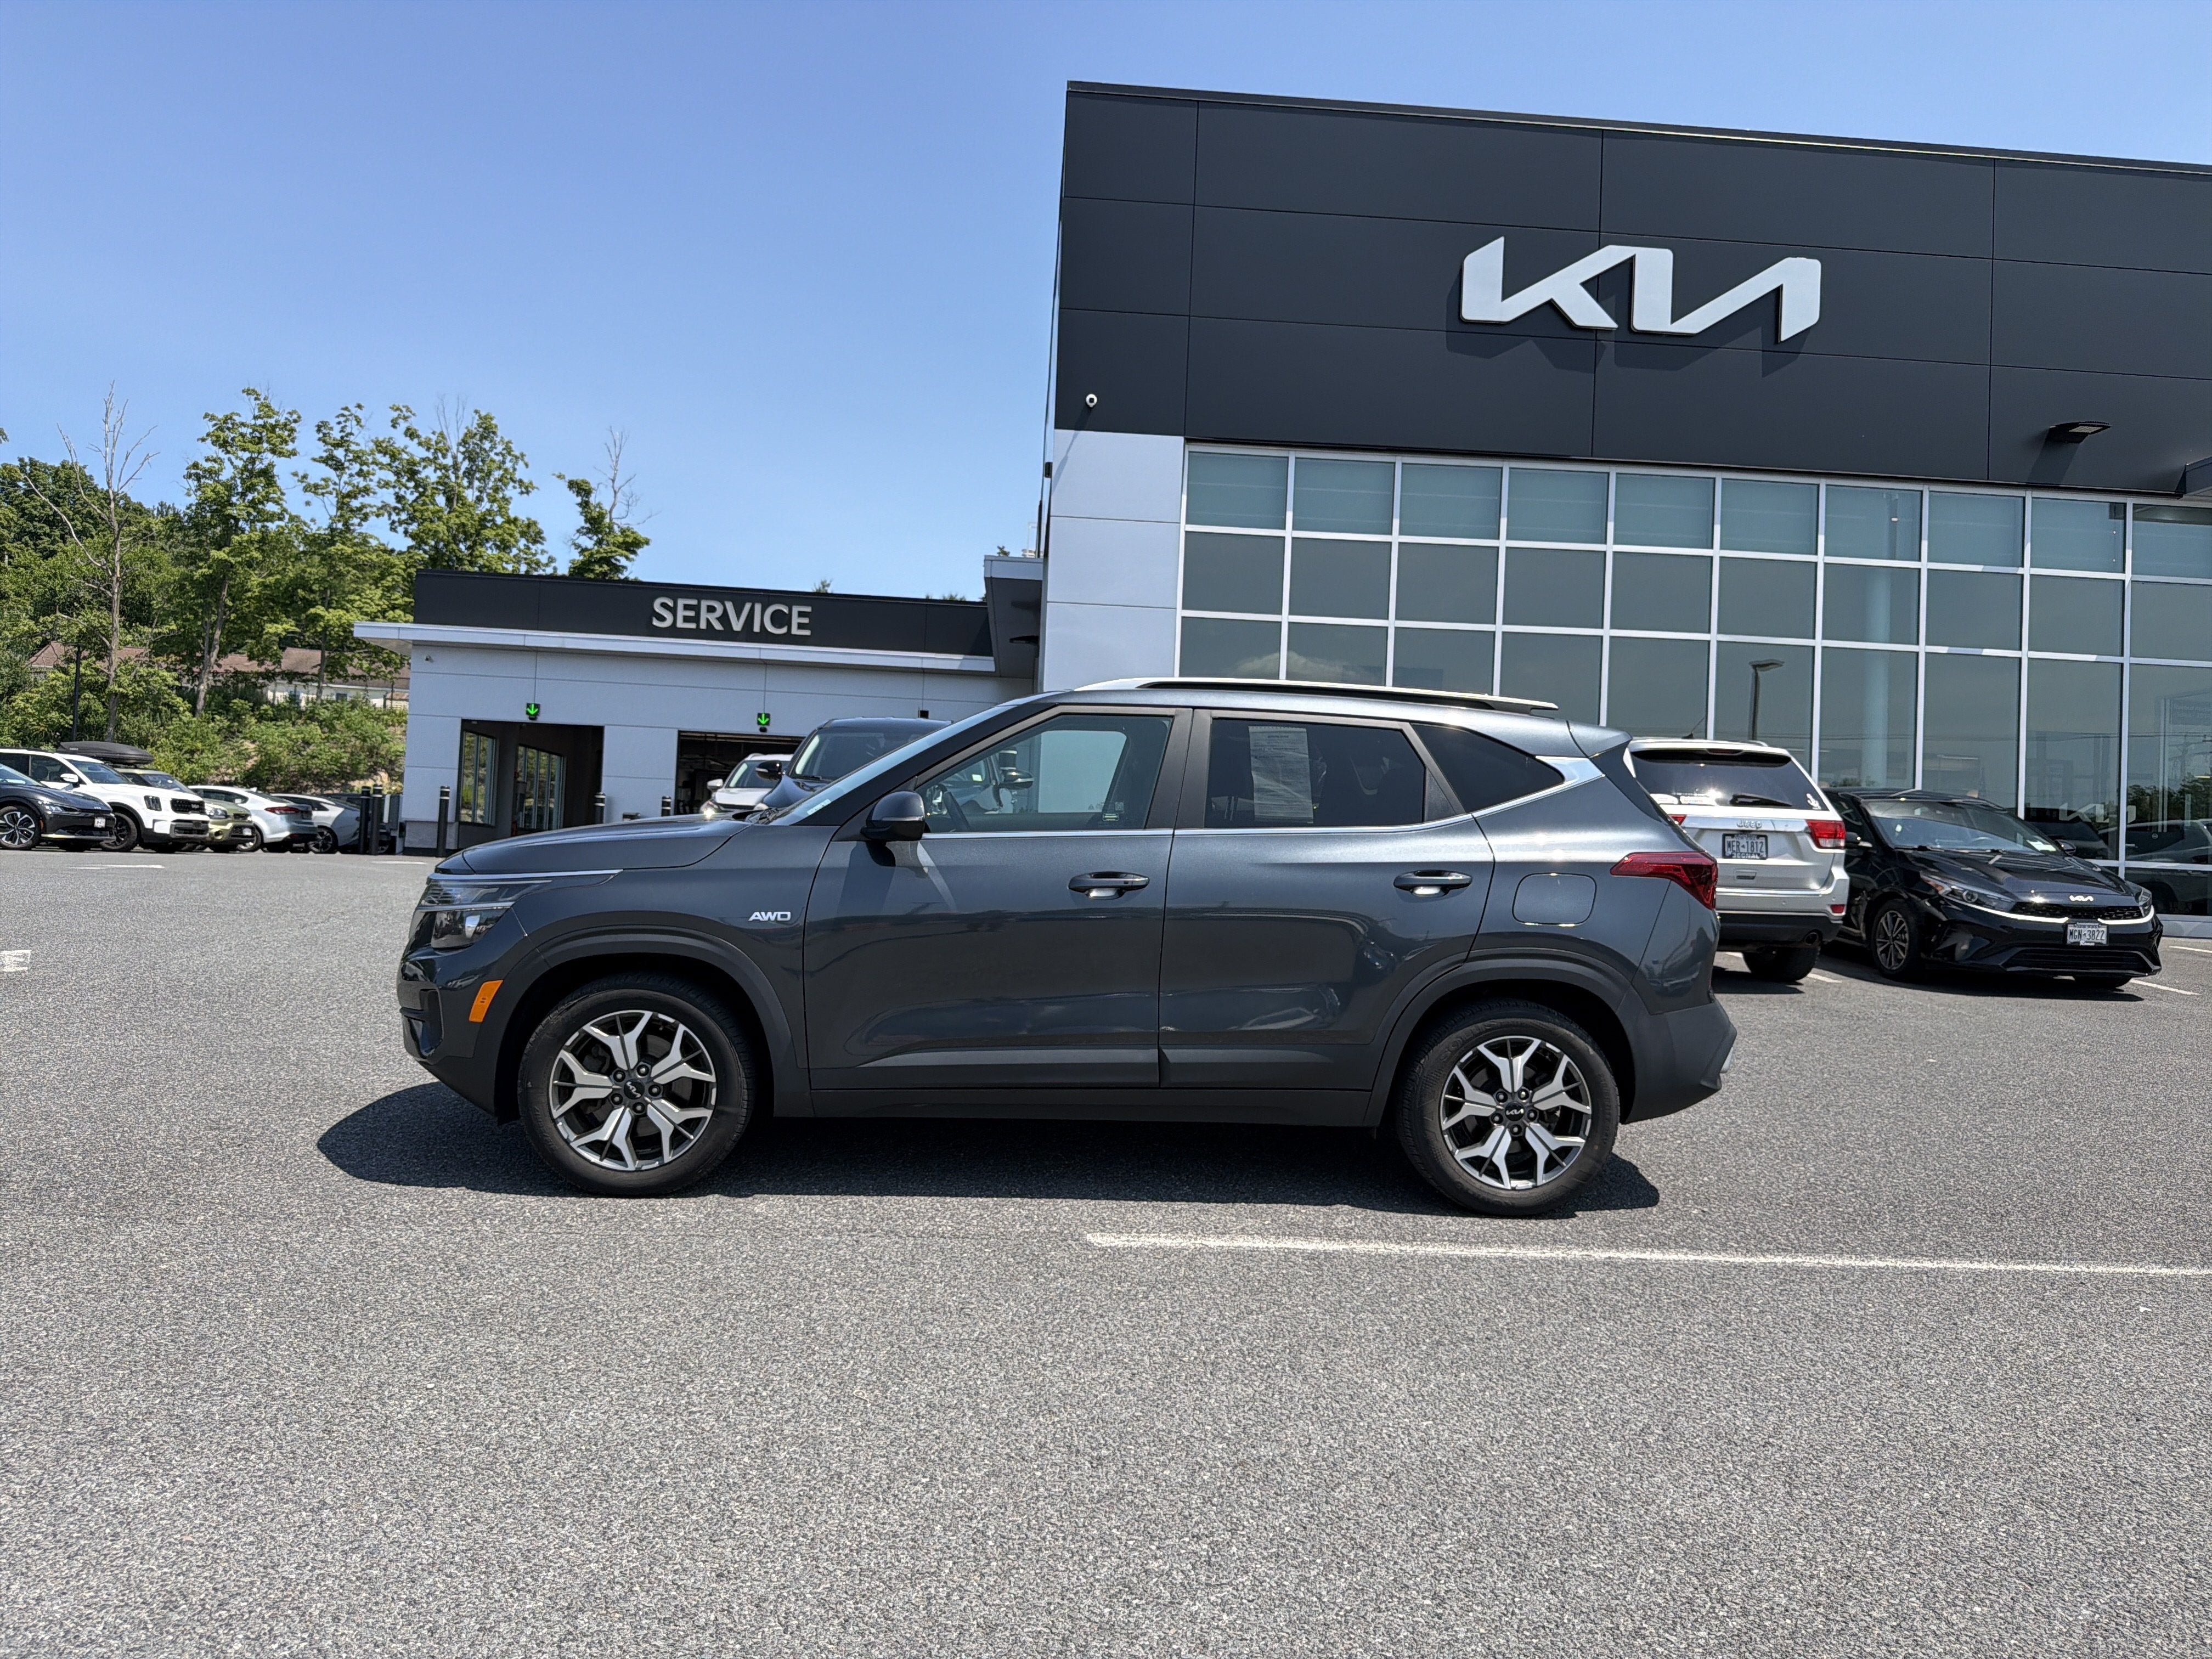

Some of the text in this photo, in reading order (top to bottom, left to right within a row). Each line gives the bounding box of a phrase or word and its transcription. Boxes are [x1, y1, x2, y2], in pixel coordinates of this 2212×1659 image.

[1460, 236, 1821, 343] KIA
[652, 597, 812, 636] SERVICE
[1736, 820, 1762, 830] Jeep
[748, 911, 791, 921] AWD
